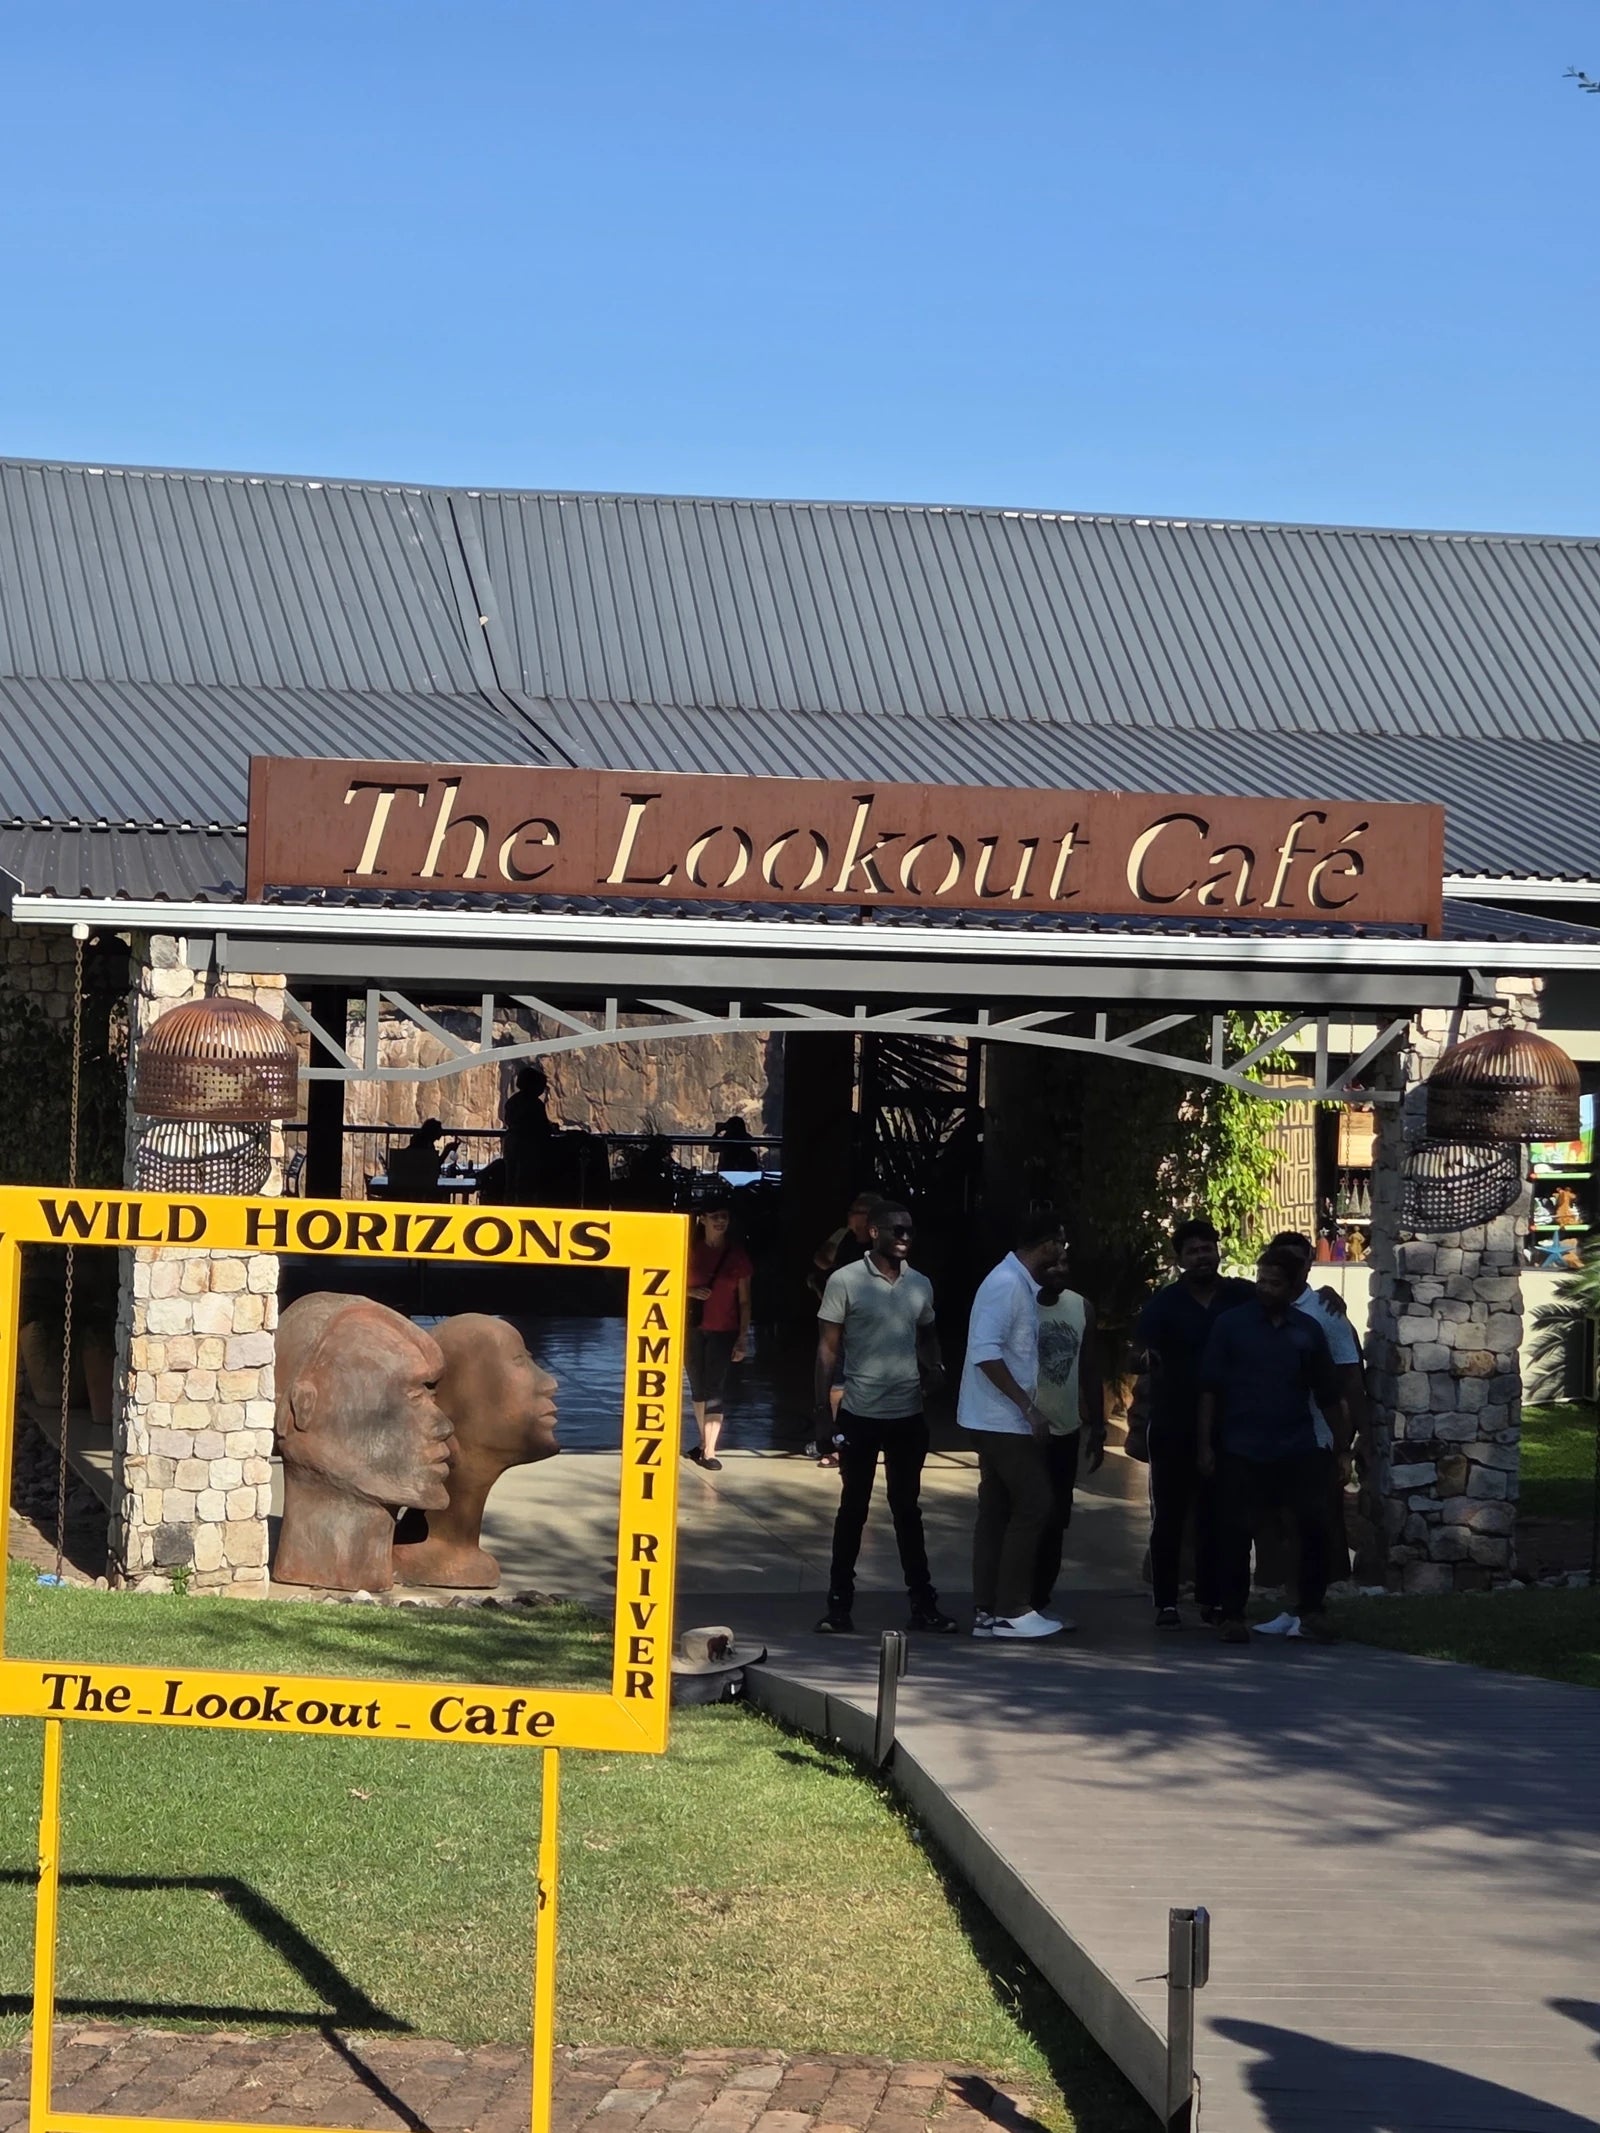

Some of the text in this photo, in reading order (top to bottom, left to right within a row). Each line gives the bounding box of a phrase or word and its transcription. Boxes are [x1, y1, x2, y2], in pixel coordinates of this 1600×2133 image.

[344, 777, 1369, 911] The Lookout Café
[40, 1199, 611, 1261] WILD HORIZONS
[626, 1269, 670, 1699] ZAMBEZI RIVER
[42, 1673, 131, 1713] The
[162, 1681, 381, 1730] Lookout
[430, 1696, 556, 1738] Cafe
